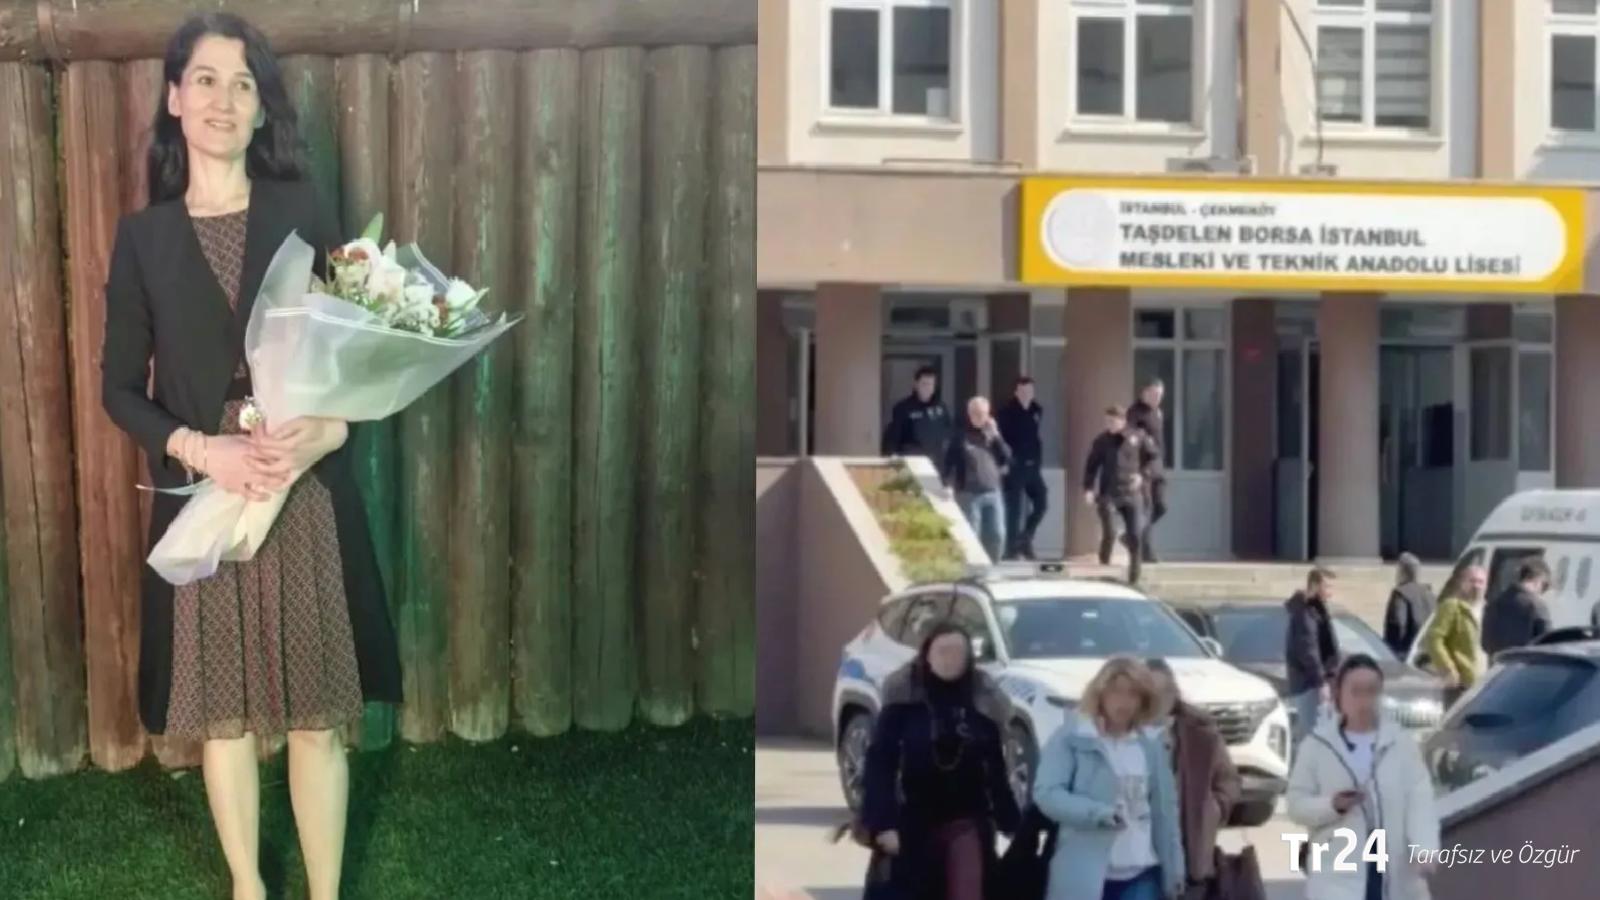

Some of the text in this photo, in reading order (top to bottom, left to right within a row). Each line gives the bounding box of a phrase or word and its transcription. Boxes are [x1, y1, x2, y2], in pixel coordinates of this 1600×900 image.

[1119, 223, 1426, 247] TAŞDELEN BORSA İSTANBUL
[1119, 250, 1521, 274] MESLEKİ VE TEKNİK ANADOLU LİSESİ
